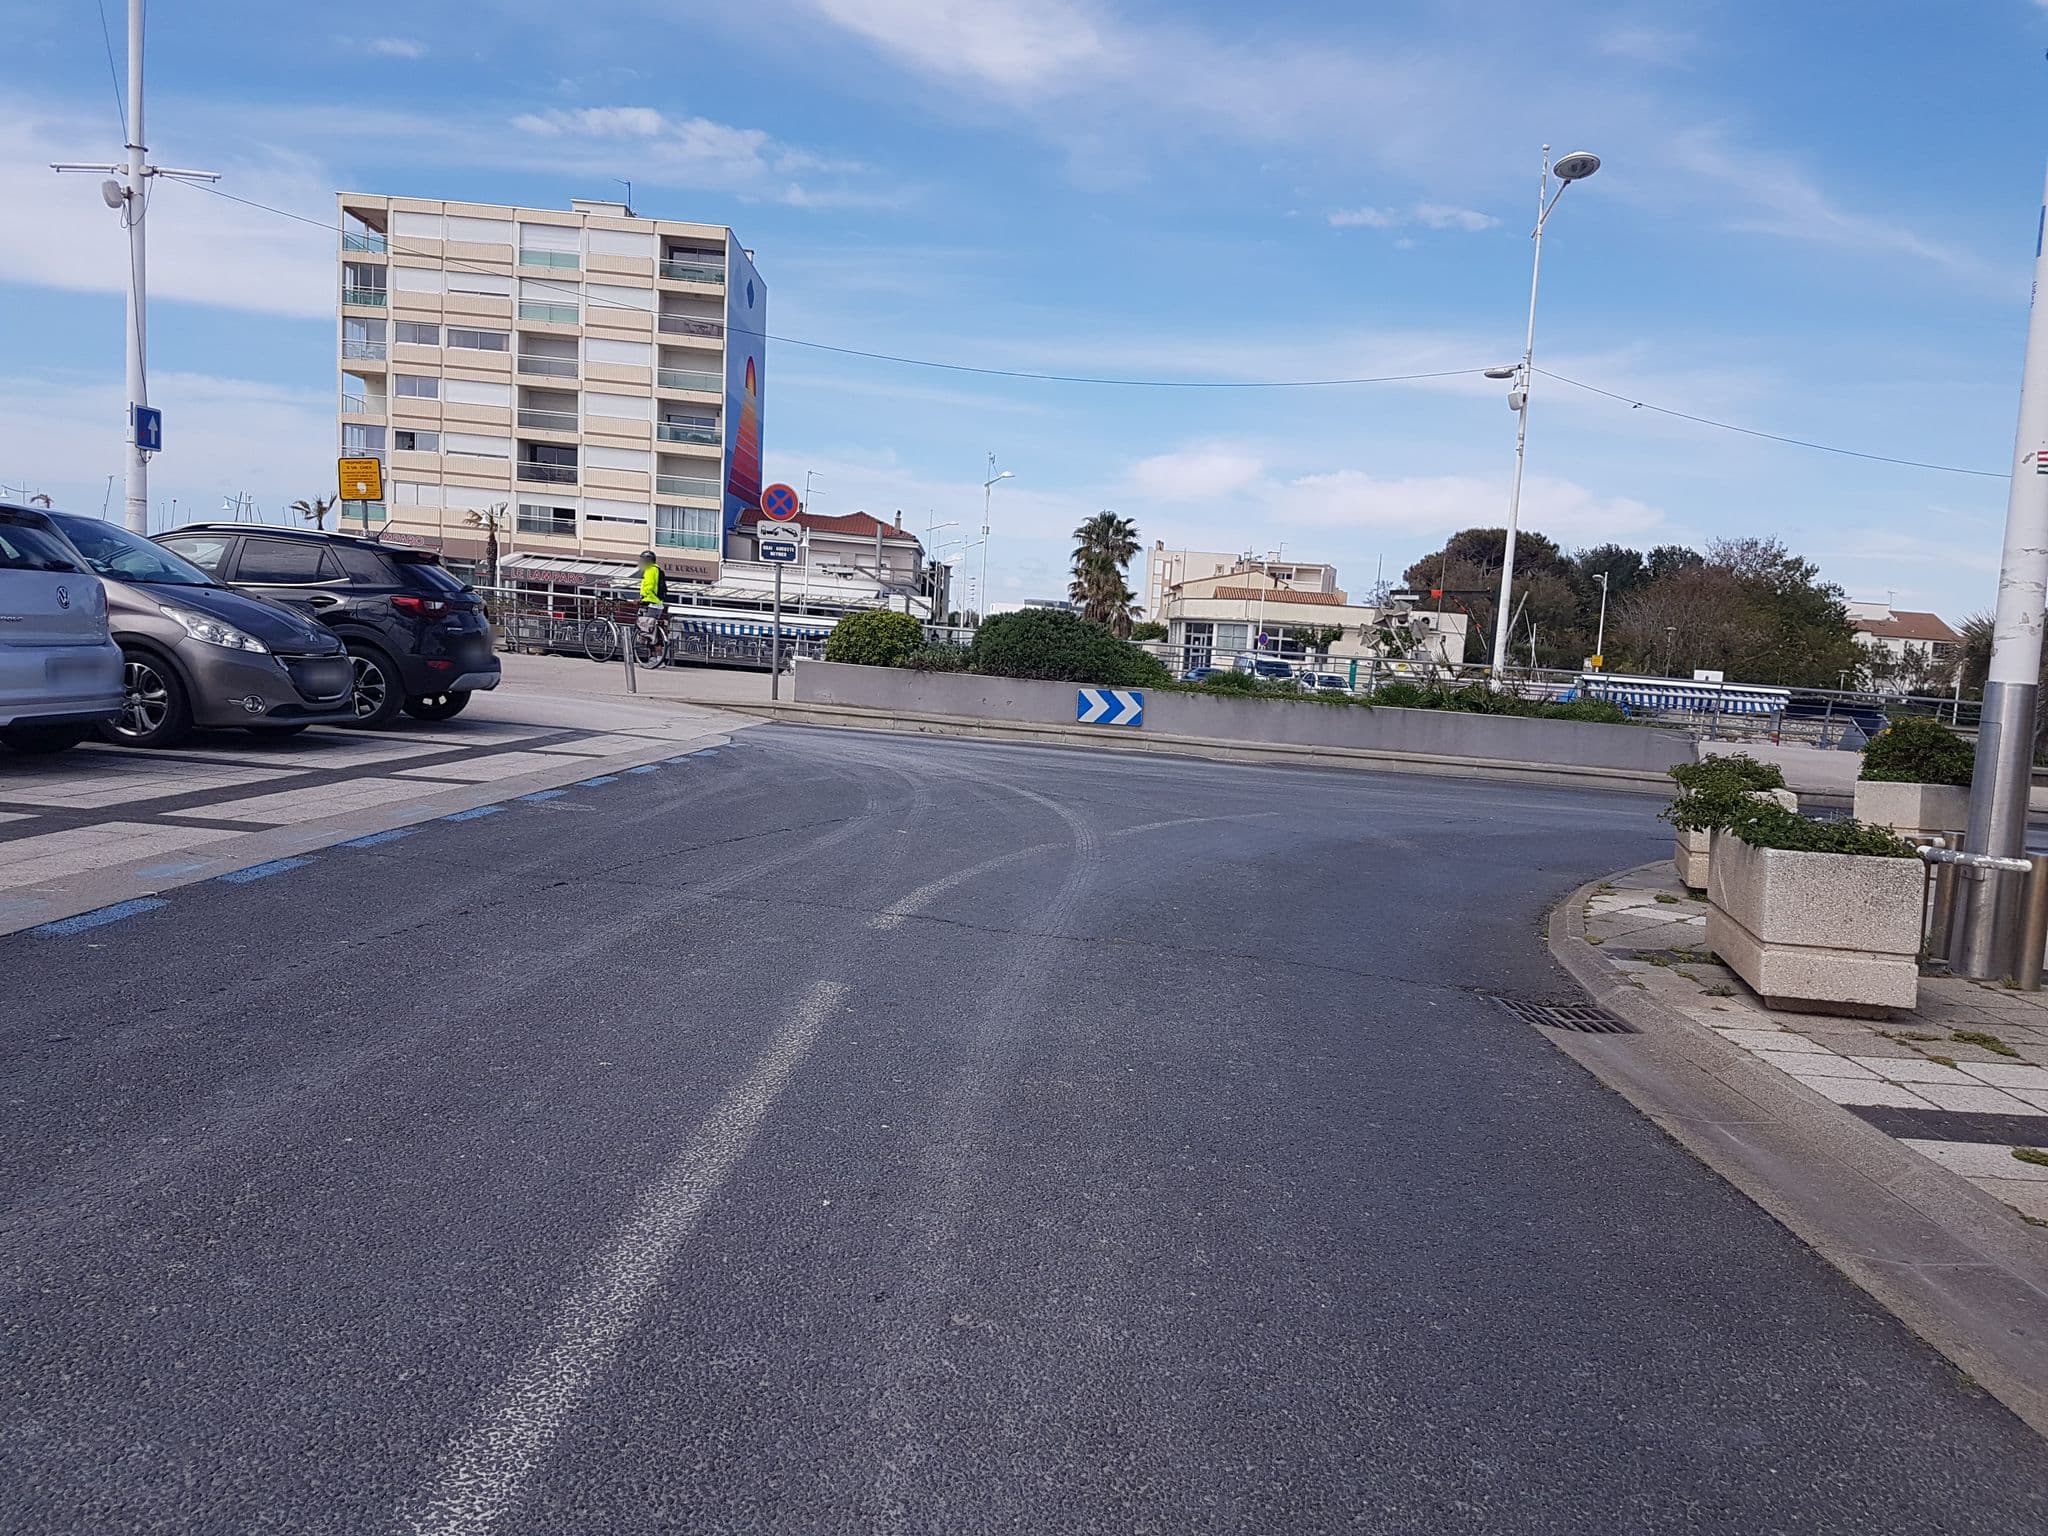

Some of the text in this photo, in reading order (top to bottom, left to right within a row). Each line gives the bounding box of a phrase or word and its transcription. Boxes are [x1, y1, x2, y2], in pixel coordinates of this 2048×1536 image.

[664, 563, 708, 574] LE KURSAAL
[510, 567, 587, 585] LE LAMPARO
